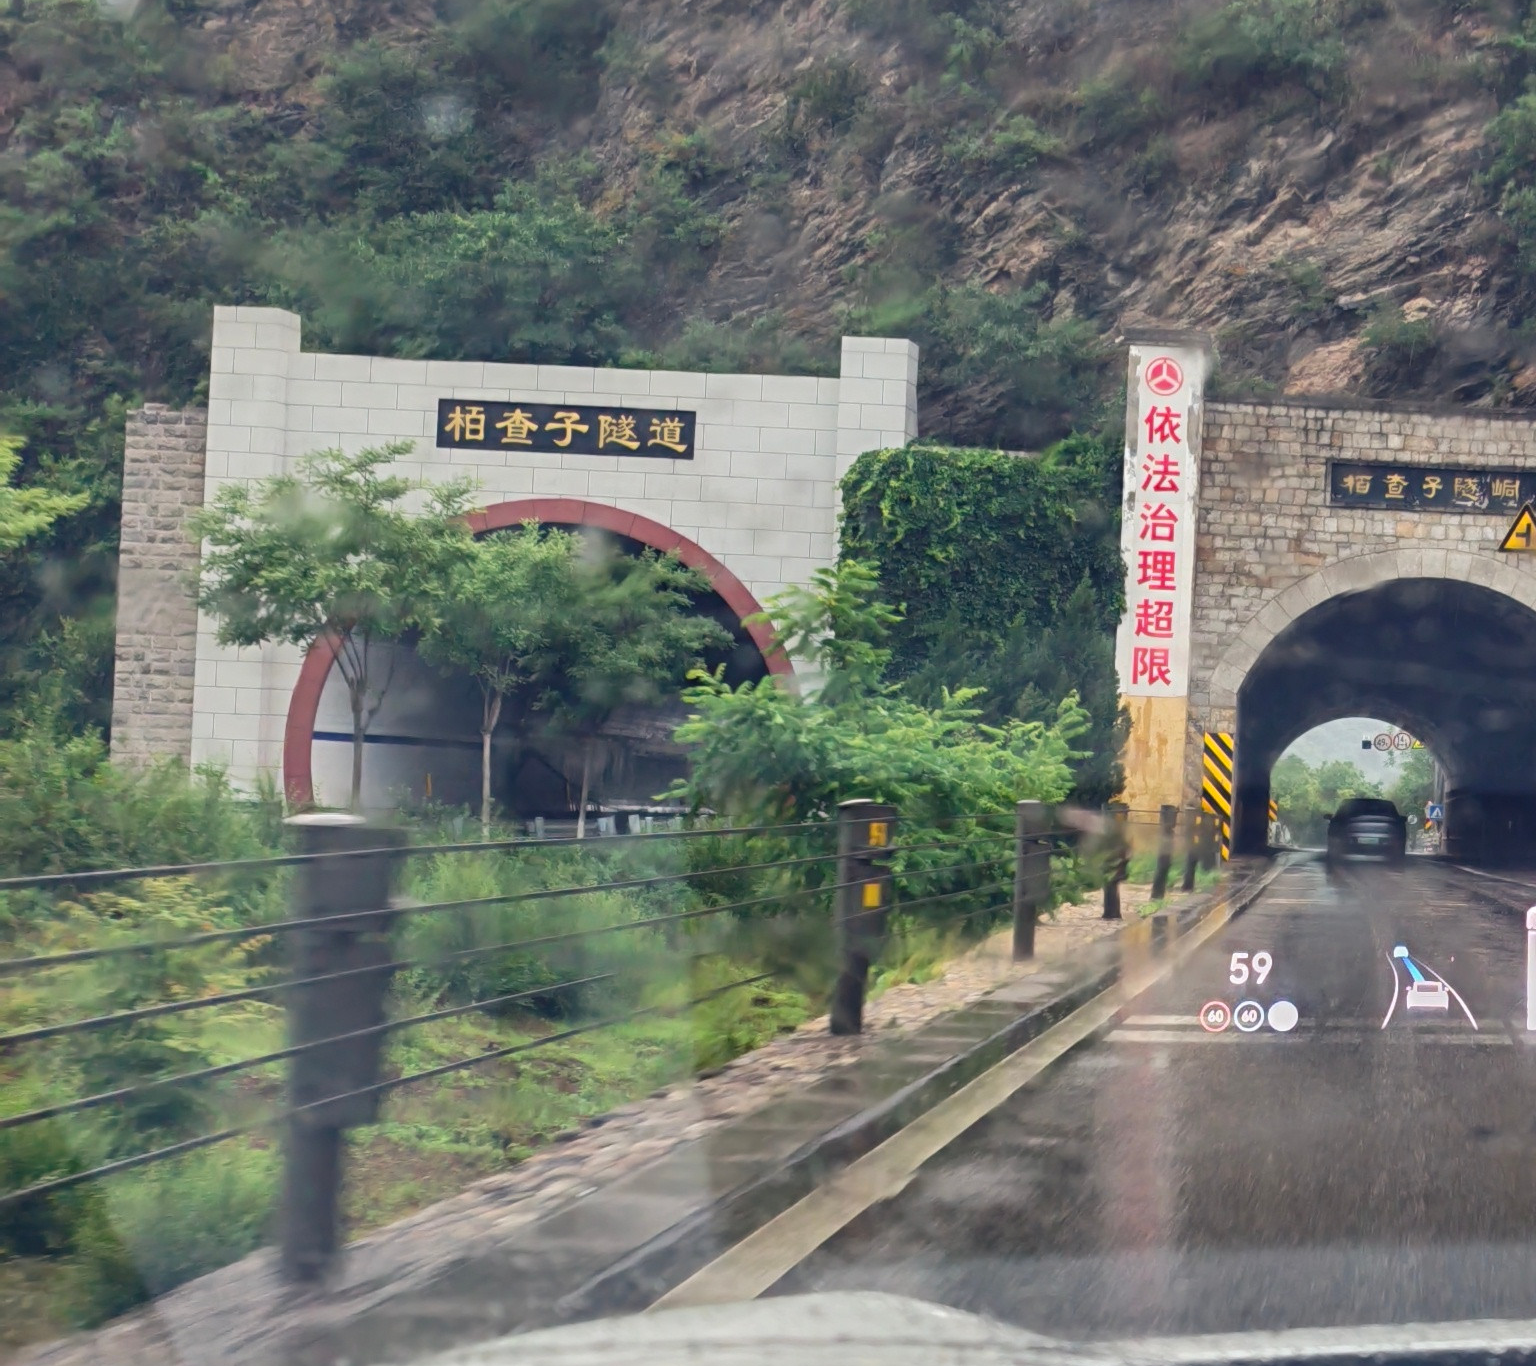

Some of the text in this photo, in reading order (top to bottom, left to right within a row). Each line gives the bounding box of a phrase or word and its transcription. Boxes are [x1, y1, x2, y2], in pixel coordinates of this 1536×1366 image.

[1131, 405, 1183, 686] 依法治理超限
[1229, 951, 1273, 985] 59
[1207, 1009, 1224, 1023] 60
[1241, 1009, 1258, 1023] 60
